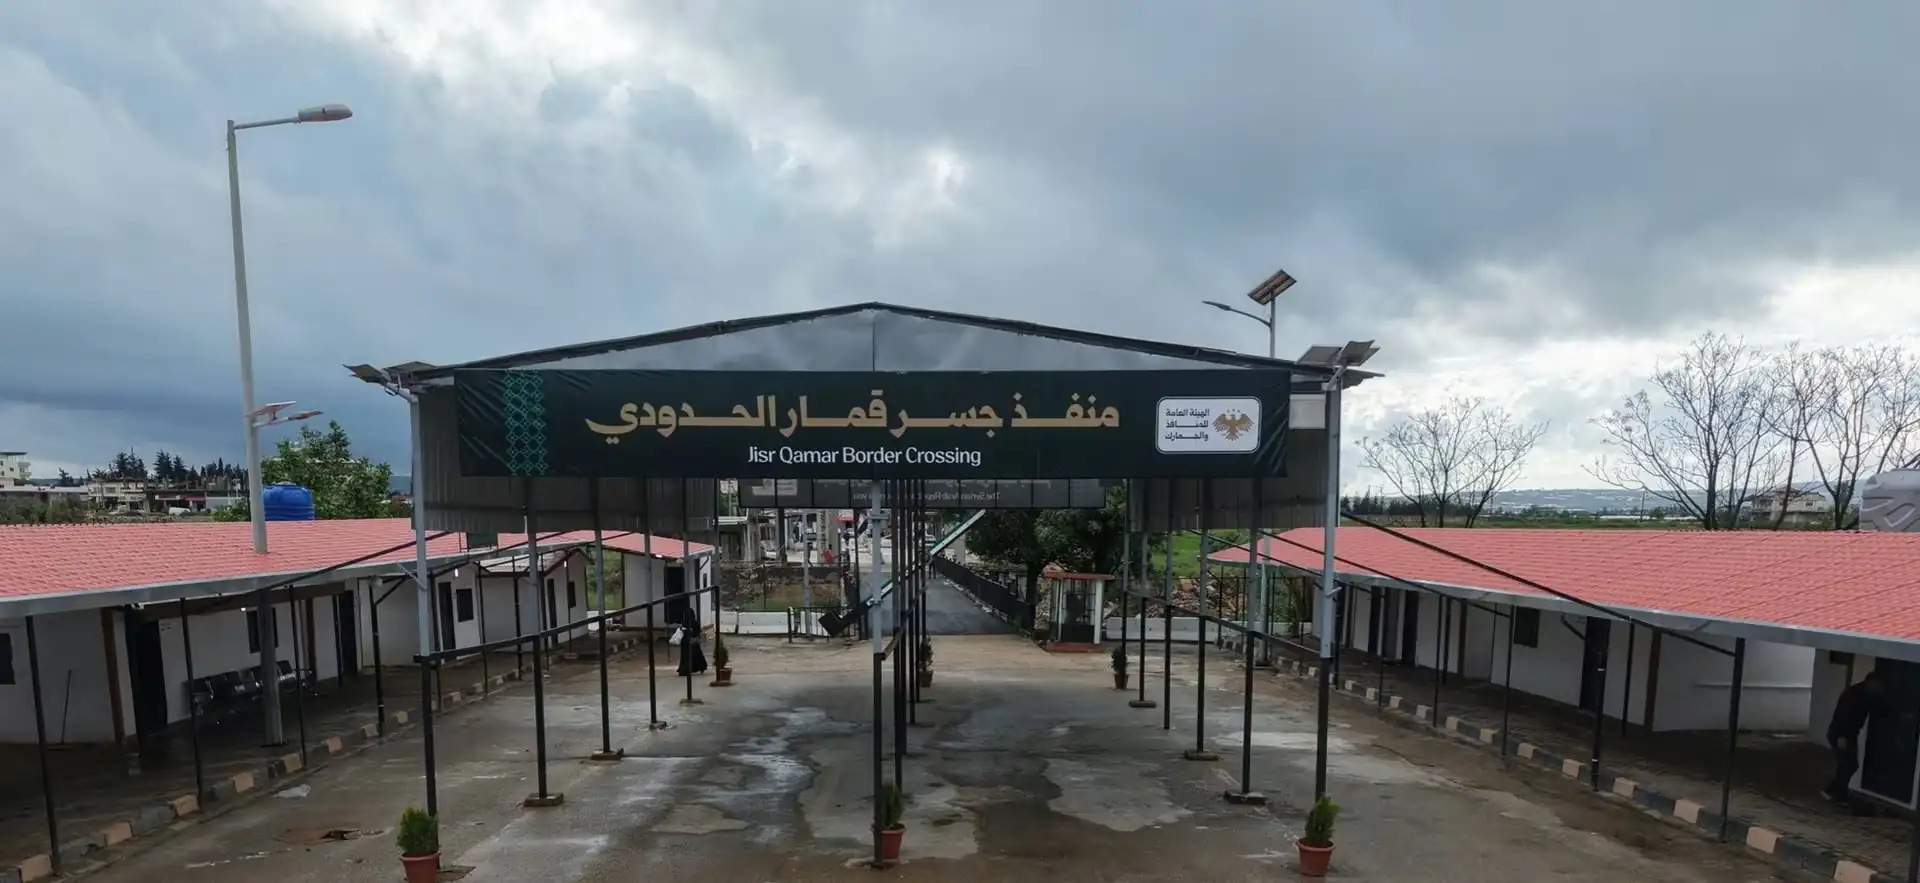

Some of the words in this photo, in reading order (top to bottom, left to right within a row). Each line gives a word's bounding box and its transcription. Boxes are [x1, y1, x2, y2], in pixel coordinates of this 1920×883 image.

[585, 394, 777, 444] الحدودي
[779, 389, 888, 438] قمار
[889, 405, 1004, 438] جسر
[1011, 392, 1120, 427] منفذ
[1165, 408, 1188, 417] العامة
[748, 446, 776, 463] Jisr
[779, 446, 839, 464] Qamar
[843, 446, 902, 464] Border
[905, 446, 981, 467] Crossing
